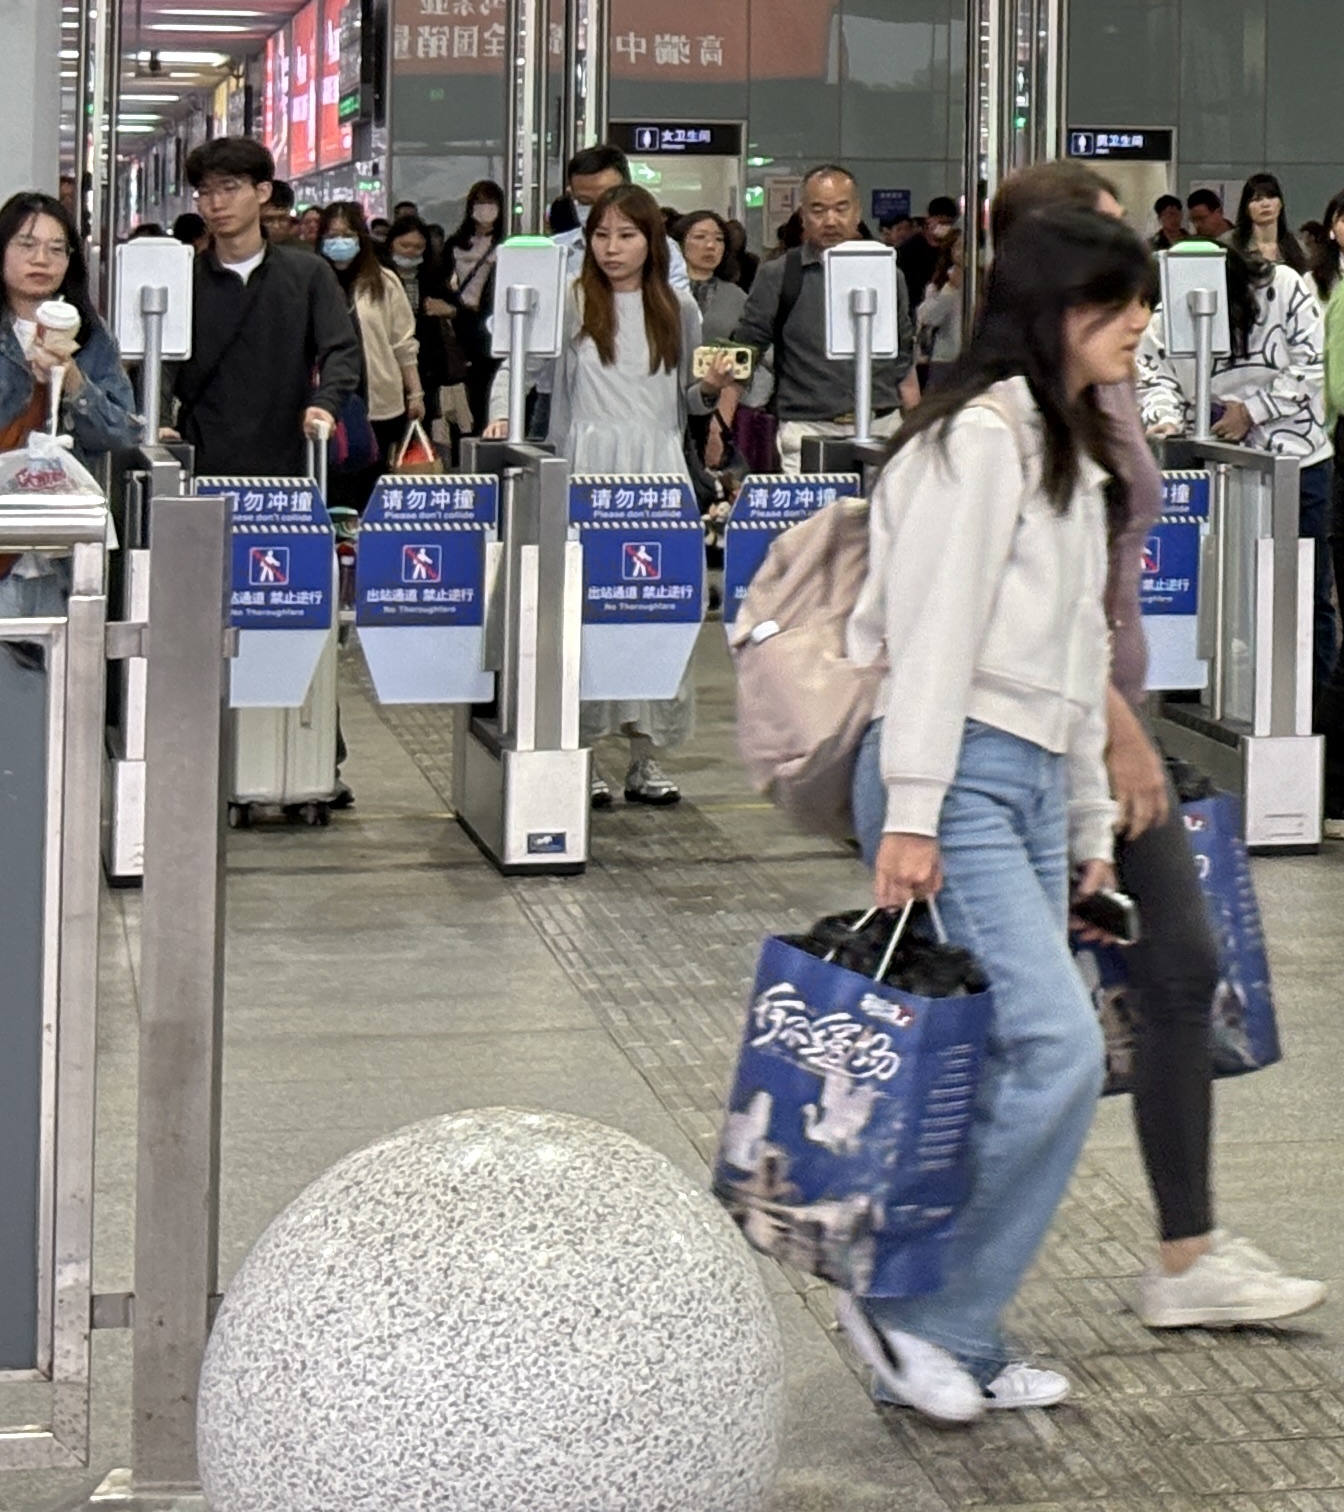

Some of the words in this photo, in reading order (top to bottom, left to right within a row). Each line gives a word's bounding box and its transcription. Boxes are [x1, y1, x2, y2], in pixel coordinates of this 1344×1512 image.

[382, 488, 475, 510] 请勿冲撞
[590, 487, 682, 509] 请勿冲撞
